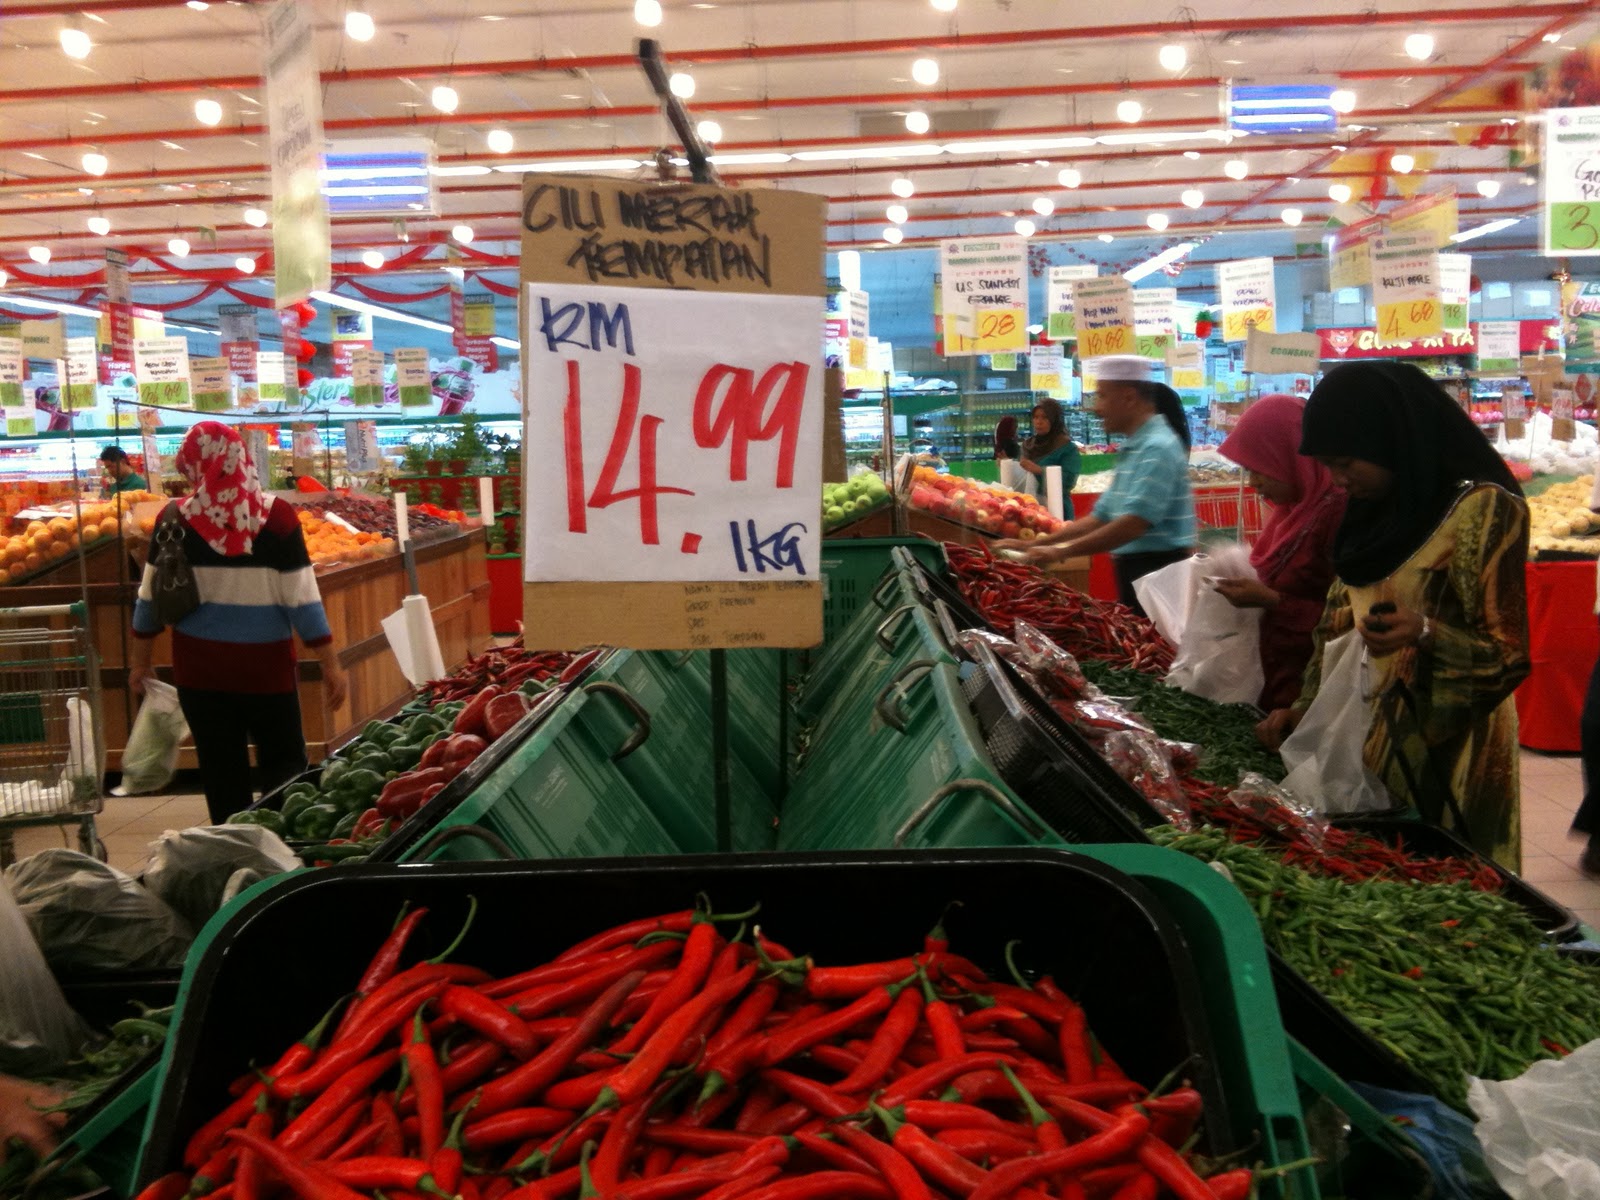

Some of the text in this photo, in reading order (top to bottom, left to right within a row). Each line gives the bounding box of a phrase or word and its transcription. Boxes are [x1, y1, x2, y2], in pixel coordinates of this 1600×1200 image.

[540, 297, 635, 356] RM
[1270, 347, 1315, 358] ECONSAVE
[564, 360, 811, 555] 14.99
